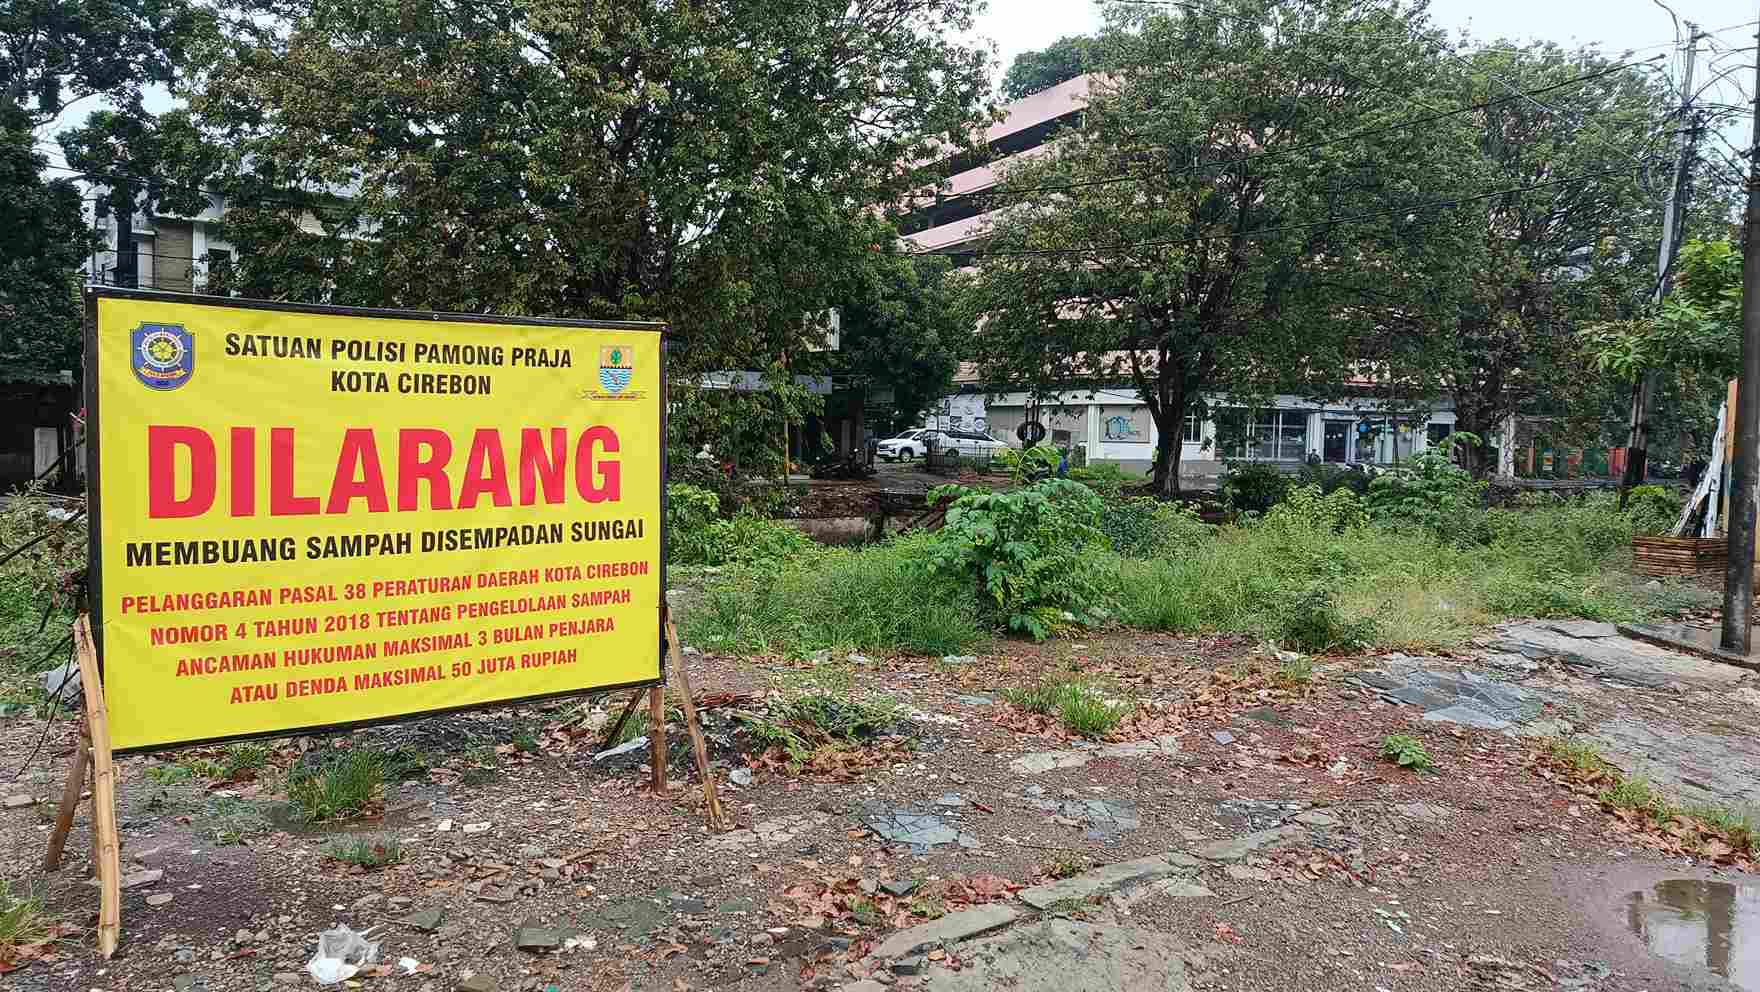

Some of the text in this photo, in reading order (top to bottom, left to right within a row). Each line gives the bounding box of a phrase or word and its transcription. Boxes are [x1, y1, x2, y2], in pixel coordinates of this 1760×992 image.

[225, 332, 572, 369] SATUAN POLISI PAMONG PRAJA
[331, 370, 491, 396] KOTA CIREBON
[147, 424, 621, 520] DILARANG
[126, 518, 644, 568] MEMBUANG SAMPAH DISEMPADAN SUNGAI
[121, 560, 649, 615] PELANGGARAN PASAL 38 PERATURAN DAERAH KOTA CIREBON
[150, 588, 631, 646] NOMOR 4 TAHUN 2018 TENTANG PENGELOLAAN SAMPAH
[175, 617, 615, 677] ANCAMAN HUKUMAN MAKSIMAL 3 BULAN PENJARA
[230, 648, 577, 705] ATAU DENDA MAKSIMAL 50 JUTA RUPIAH
